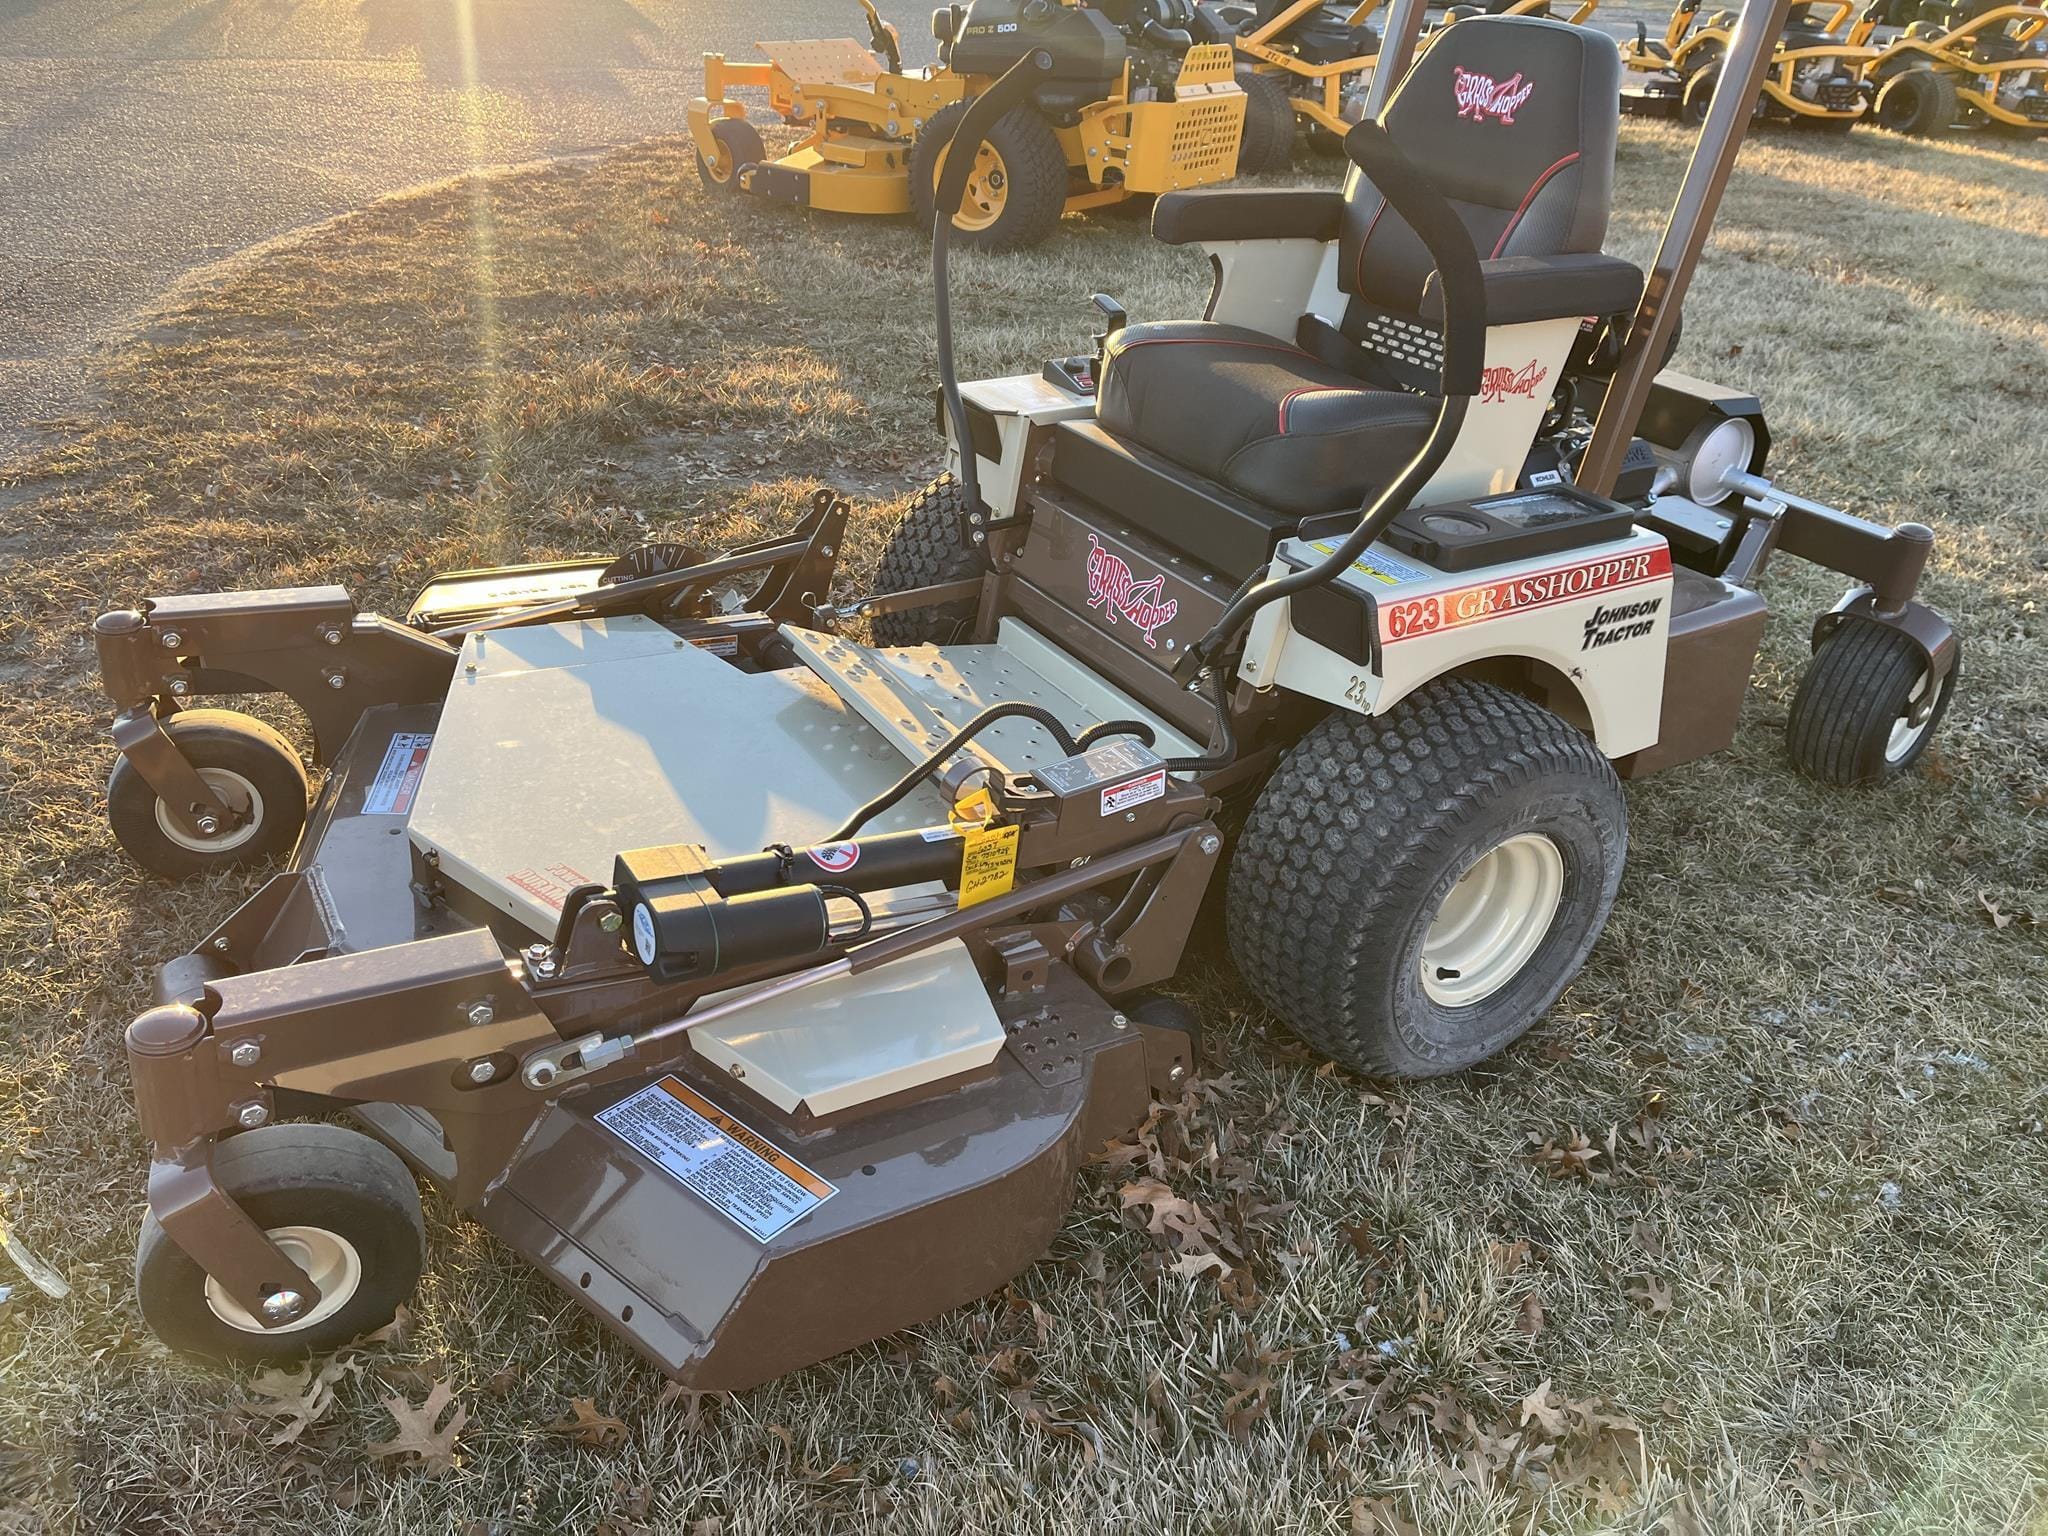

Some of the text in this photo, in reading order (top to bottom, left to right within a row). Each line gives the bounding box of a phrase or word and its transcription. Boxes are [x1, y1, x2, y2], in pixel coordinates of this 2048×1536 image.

[967, 26, 985, 34] PRO
[997, 23, 1017, 33] 500
[602, 574, 635, 584] CUTTING
[1389, 598, 1440, 638] 623
[1456, 554, 1650, 619] GRASSHOPPER
[1584, 597, 1663, 629] JOHNSON
[1581, 619, 1655, 651] TRACTOR
[638, 1124, 655, 1136] MOWER
[668, 1099, 691, 1115] SERIOUS
[689, 1114, 708, 1127] INJURY
[707, 1126, 720, 1135] CAN
[737, 1148, 755, 1160] FROM
[753, 1159, 777, 1175] FAILURE
[724, 1124, 781, 1162] WARNING
[698, 1168, 717, 1181] UNEVEN
[724, 1152, 743, 1164] REMOVE
[750, 1170, 767, 1181] BEFORE
[765, 1180, 781, 1192] DOING
[780, 1191, 798, 1204] SERVICE
[739, 1157, 757, 1169] ENGINE
[755, 1167, 772, 1179] BEFORE
[706, 1185, 726, 1199] OPERATE
[730, 1202, 757, 1222] TRANSPORT
[708, 1169, 727, 1182] CAREFUL
[726, 1181, 741, 1192] WHEN
[739, 1191, 765, 1209] OPERATING
